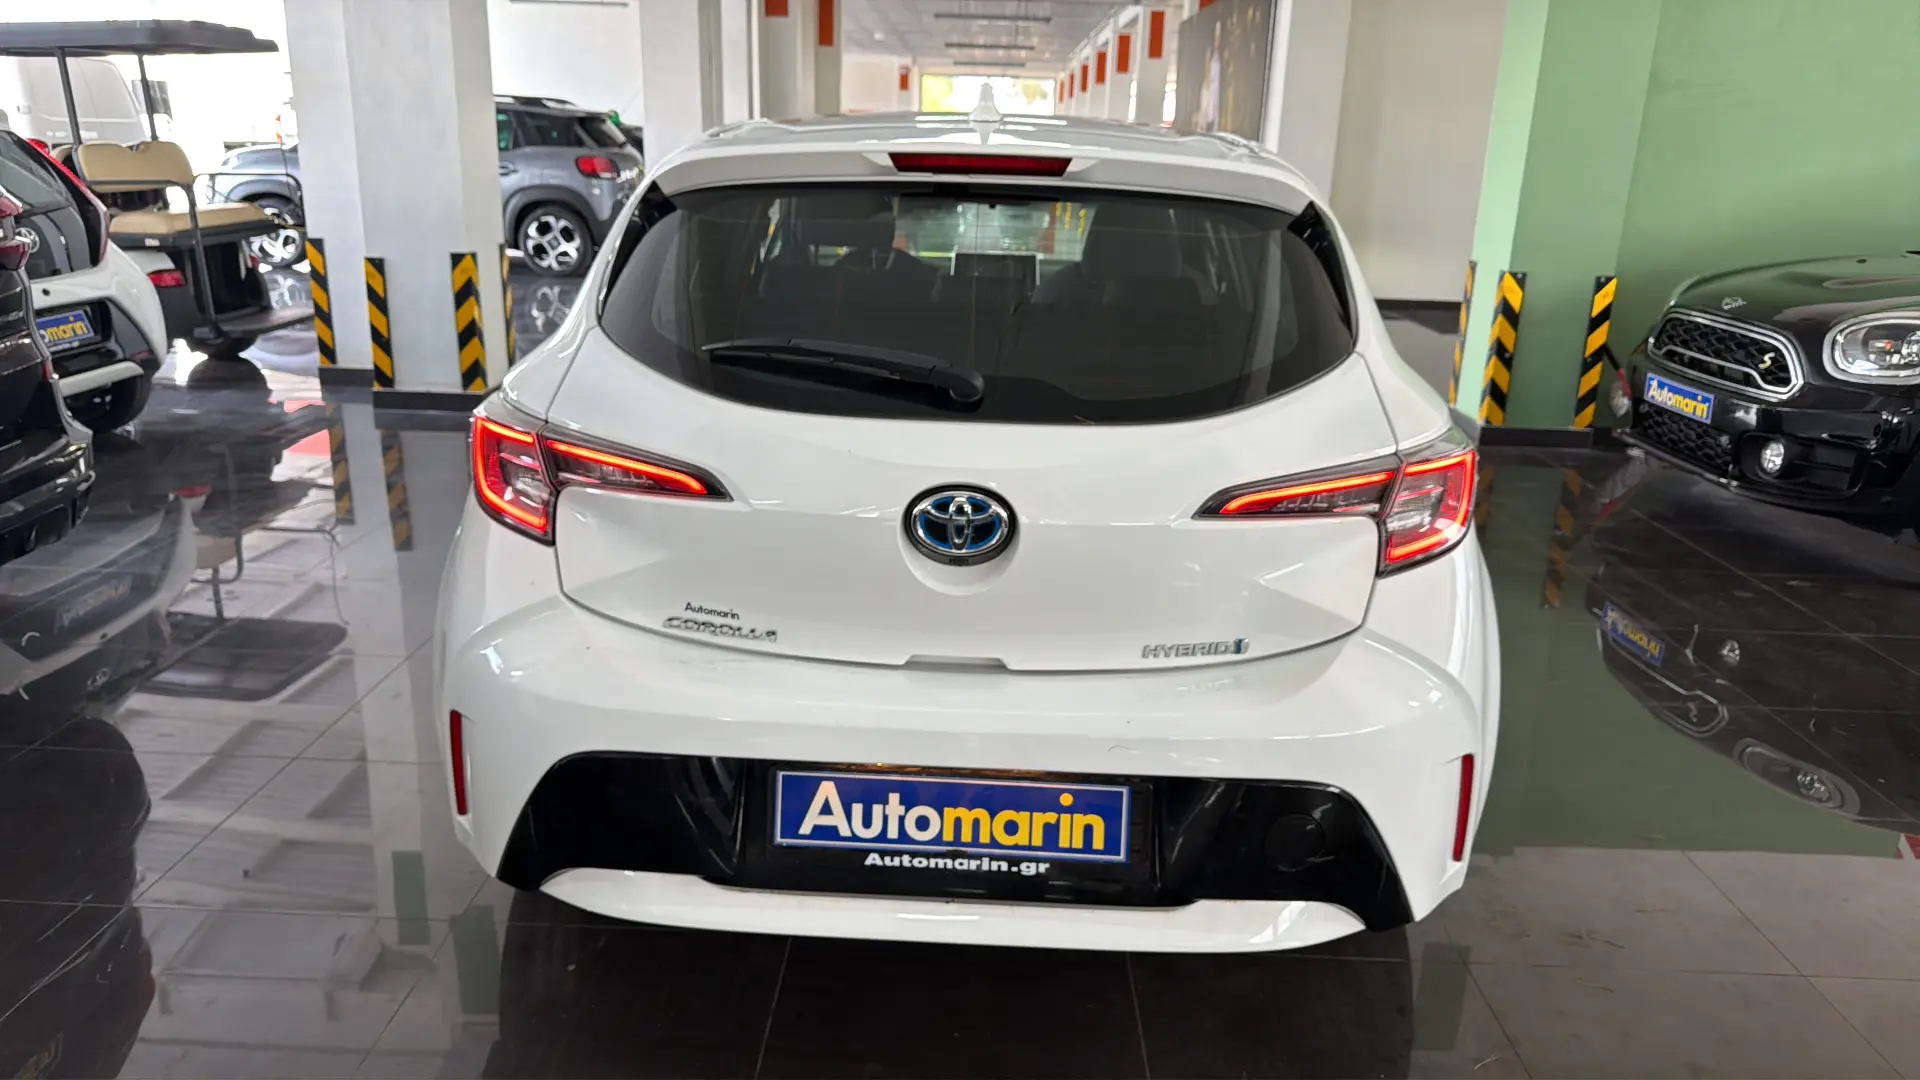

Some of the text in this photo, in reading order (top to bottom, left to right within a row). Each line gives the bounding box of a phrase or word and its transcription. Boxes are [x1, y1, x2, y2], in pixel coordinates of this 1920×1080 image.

[39, 315, 88, 342] omarin
[1648, 379, 1708, 419] Automarin
[684, 601, 741, 621] Automarin
[1141, 640, 1233, 659] HYBRID
[797, 779, 1106, 851] Automarin
[863, 851, 1051, 877] Automarin.gr
